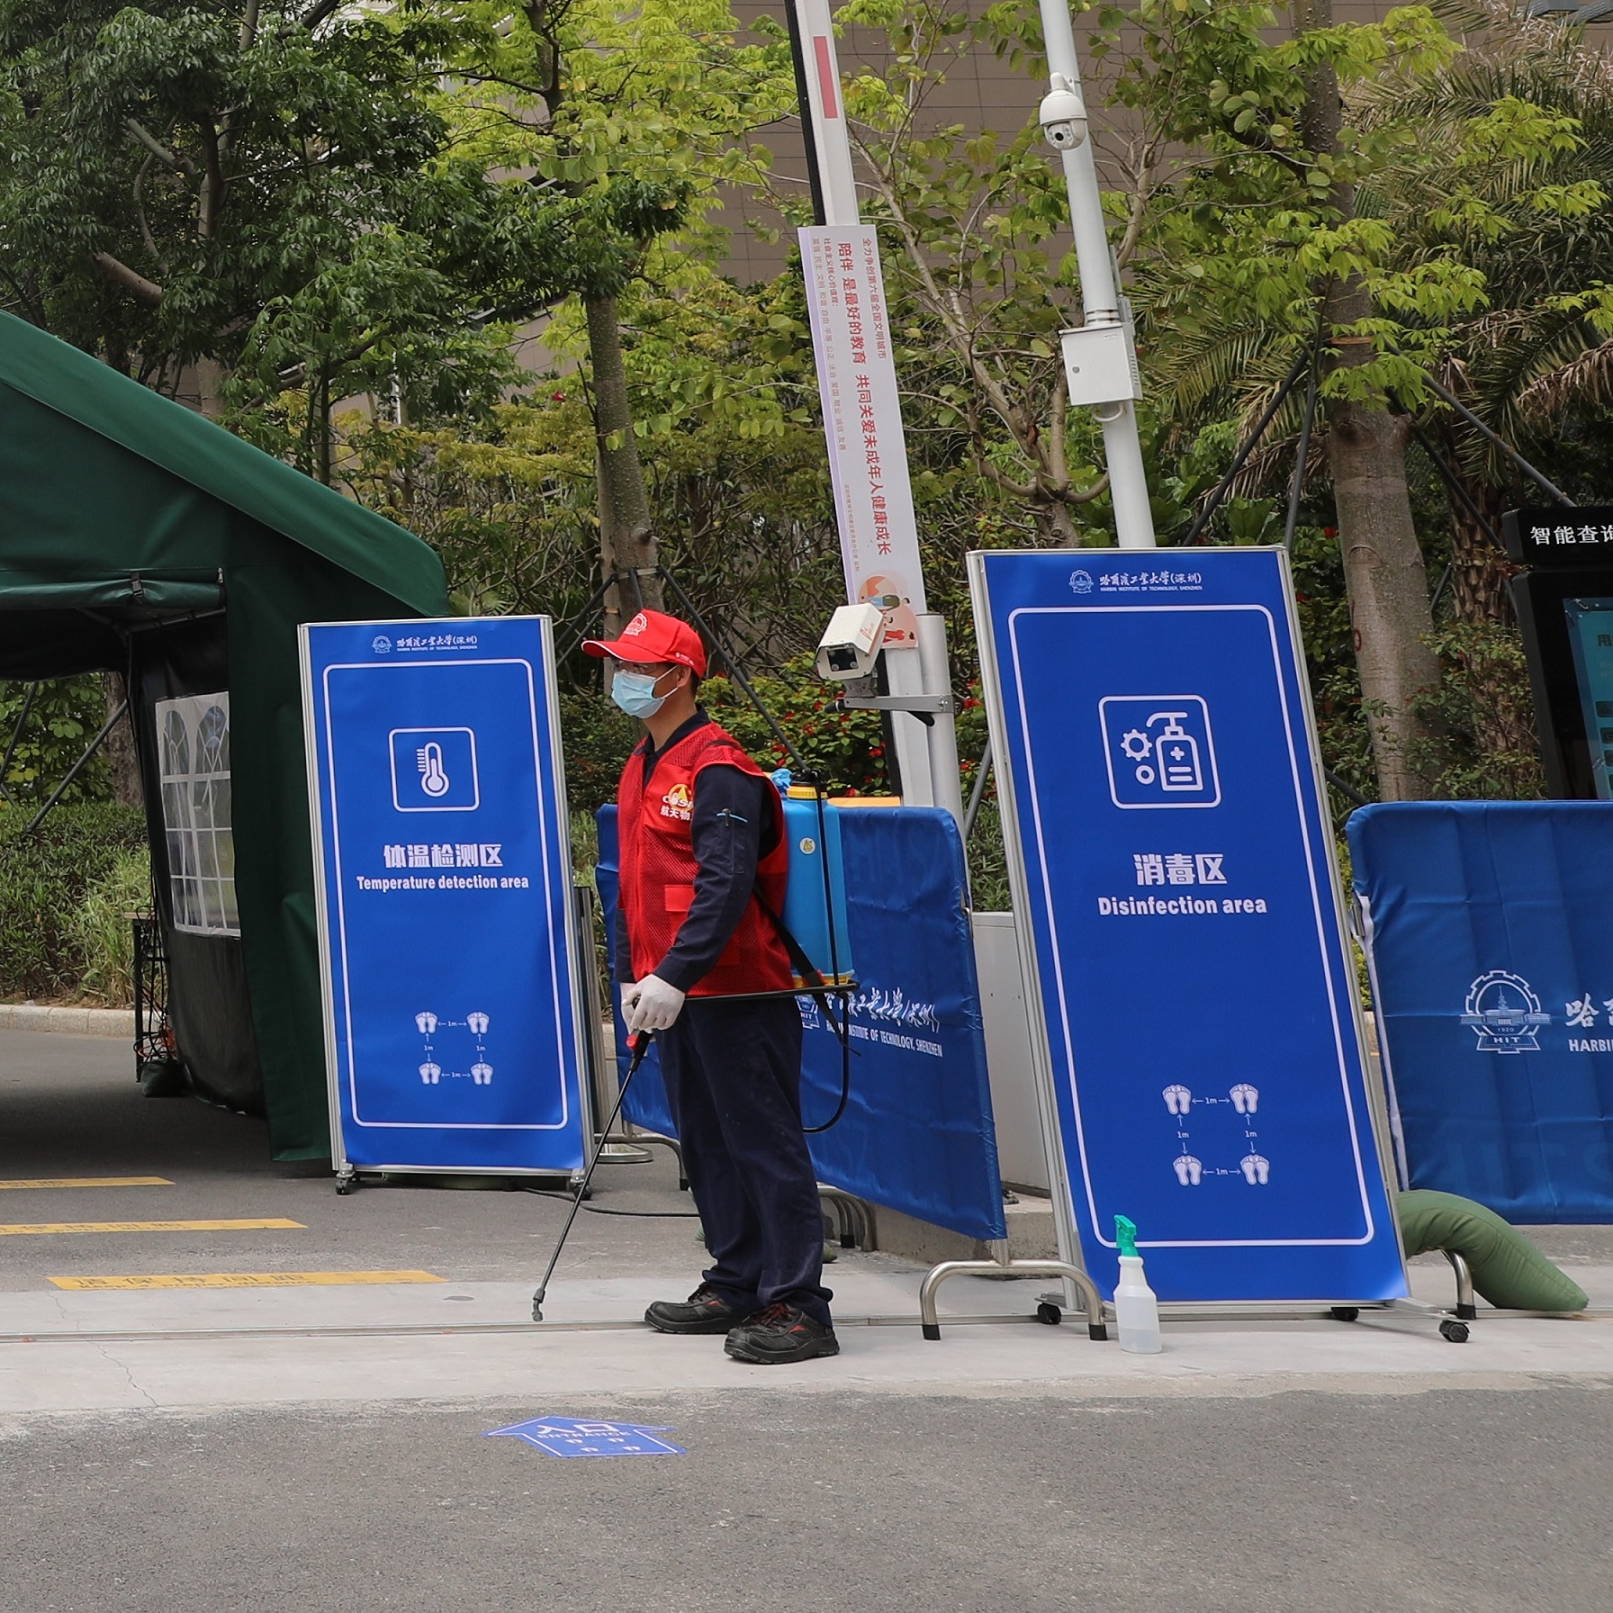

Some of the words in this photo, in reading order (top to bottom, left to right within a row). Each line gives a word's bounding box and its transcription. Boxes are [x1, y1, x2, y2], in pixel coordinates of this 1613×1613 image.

[838, 243, 853, 272] 陪伴
[862, 238, 887, 359] 全力争创第六届全国文明城市
[842, 278, 866, 364] 是最好的教育
[855, 374, 892, 555] 共同关爱未成年人健康成长
[660, 805, 692, 821] 航天物
[383, 843, 503, 869] 体温检测区
[1133, 853, 1228, 885] 消毒区
[356, 875, 436, 893] Temperature
[438, 874, 498, 889] detection
[500, 876, 529, 889] area
[1097, 895, 1218, 915] Disinfection
[1222, 898, 1267, 913] area
[870, 1029, 879, 1041] OF
[916, 1041, 943, 1058] SHENZHEN
[1568, 1039, 1613, 1052] HARBI
[537, 1424, 620, 1434] 入口
